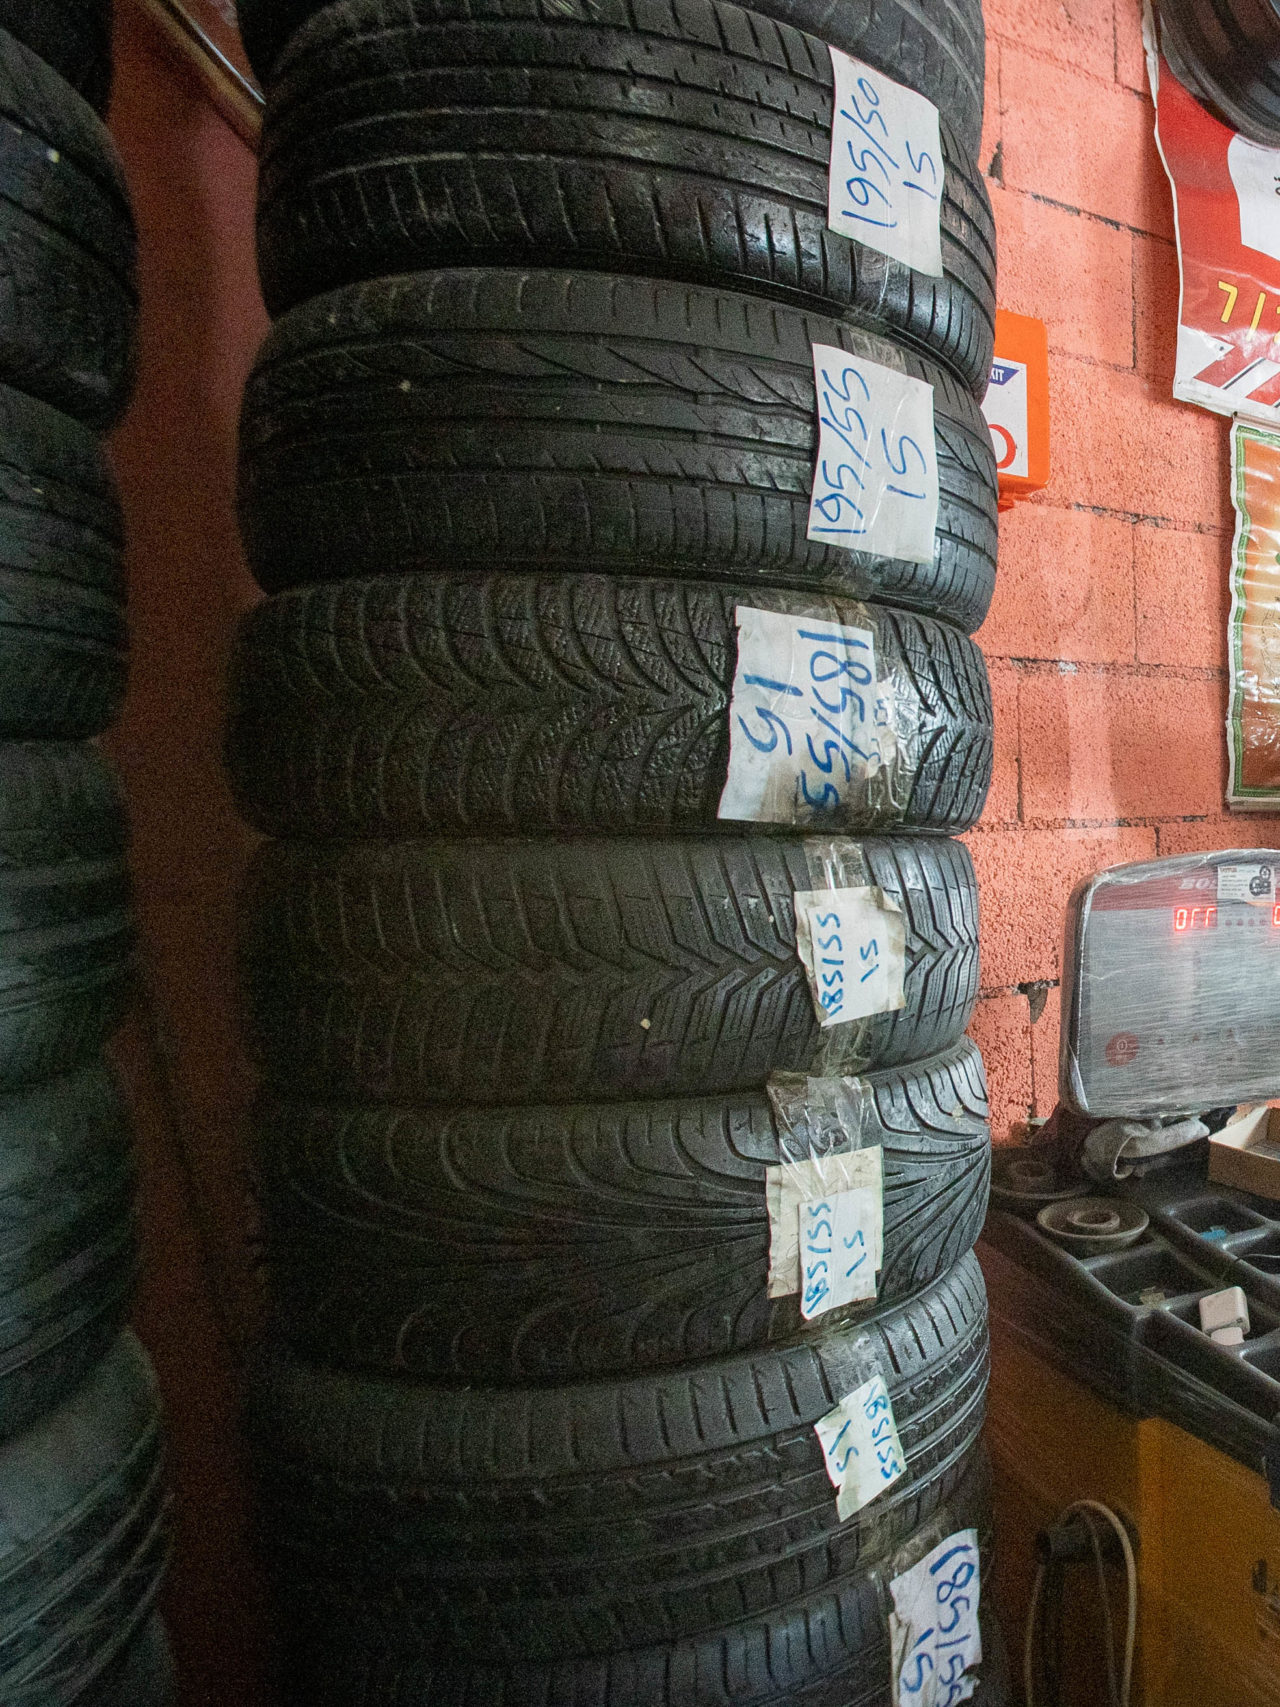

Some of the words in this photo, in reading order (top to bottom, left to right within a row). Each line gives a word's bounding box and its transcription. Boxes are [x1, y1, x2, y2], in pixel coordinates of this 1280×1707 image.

[840, 76, 900, 229] 195/50
[902, 140, 938, 201] 15
[811, 366, 873, 534] 195/55
[881, 427, 927, 500] 15
[736, 673, 804, 757] 15
[797, 628, 873, 809] 185/55
[859, 938, 880, 983] 15
[843, 1229, 867, 1278] 15
[828, 1418, 860, 1473] 15
[902, 1627, 935, 1694] 15
